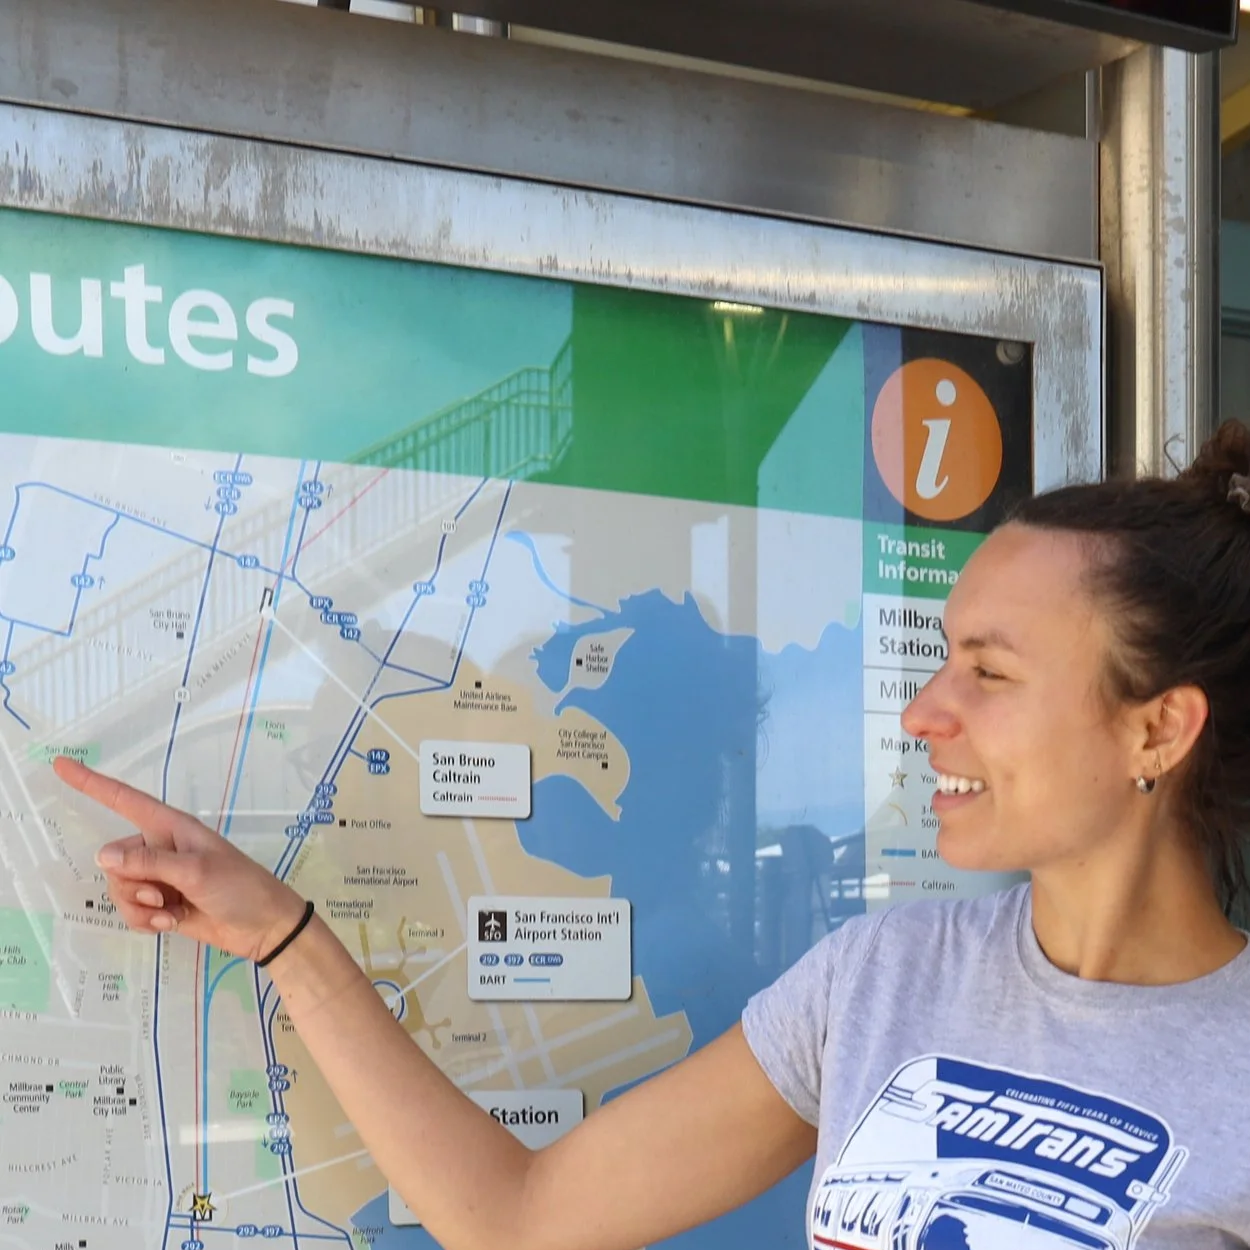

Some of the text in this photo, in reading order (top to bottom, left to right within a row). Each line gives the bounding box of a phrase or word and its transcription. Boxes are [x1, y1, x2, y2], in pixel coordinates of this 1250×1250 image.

[0, 263, 299, 378] utes
[877, 534, 946, 560] Transit
[878, 560, 961, 586] Informa
[313, 598, 330, 609] EPX
[879, 608, 943, 631] Millbra
[343, 629, 358, 640] 142
[879, 636, 945, 658] Station
[460, 690, 512, 702] United Airlines
[453, 701, 517, 712] Maintenance Base
[558, 729, 598, 741] City College
[560, 739, 605, 750] San Francisco
[881, 737, 910, 753] Map
[372, 751, 386, 760] 142
[432, 752, 495, 769] San Bruno
[556, 749, 608, 761] Airport Campus
[370, 764, 387, 773] EPX
[432, 770, 481, 785] Caltrain
[432, 791, 473, 803] Caltrain
[351, 820, 391, 829] Post Office
[357, 866, 406, 876] San Francisco
[344, 876, 418, 888] International Airport
[921, 880, 955, 891] Caltrain
[98, 904, 116, 915] High
[326, 899, 373, 909] International
[514, 911, 619, 925] San Francisco Int'l
[514, 928, 601, 943] Airport Station
[98, 972, 124, 981] Green
[480, 975, 506, 985] BART
[100, 1065, 124, 1075] Public
[269, 1066, 285, 1077] 292
[59, 1079, 89, 1089] Central
[99, 1076, 126, 1086] Library
[9, 1083, 43, 1092] Millbrae
[2, 1093, 51, 1104] Community
[93, 1097, 126, 1105] Millbrae
[230, 1090, 259, 1101] Bayside
[13, 1105, 40, 1113] Center
[236, 1100, 253, 1108] Park
[93, 1107, 127, 1117] City Hall
[489, 1108, 559, 1126] Station
[1005, 1088, 1159, 1142] CELEBRATING FIFTY YEARS OF SERVICE
[273, 1143, 289, 1153] 292
[989, 1175, 1062, 1204] SAN MATEO COUNTY
[2, 1205, 30, 1217] Rotary
[7, 1216, 25, 1225] Park
[353, 1227, 384, 1237] Bayfront
